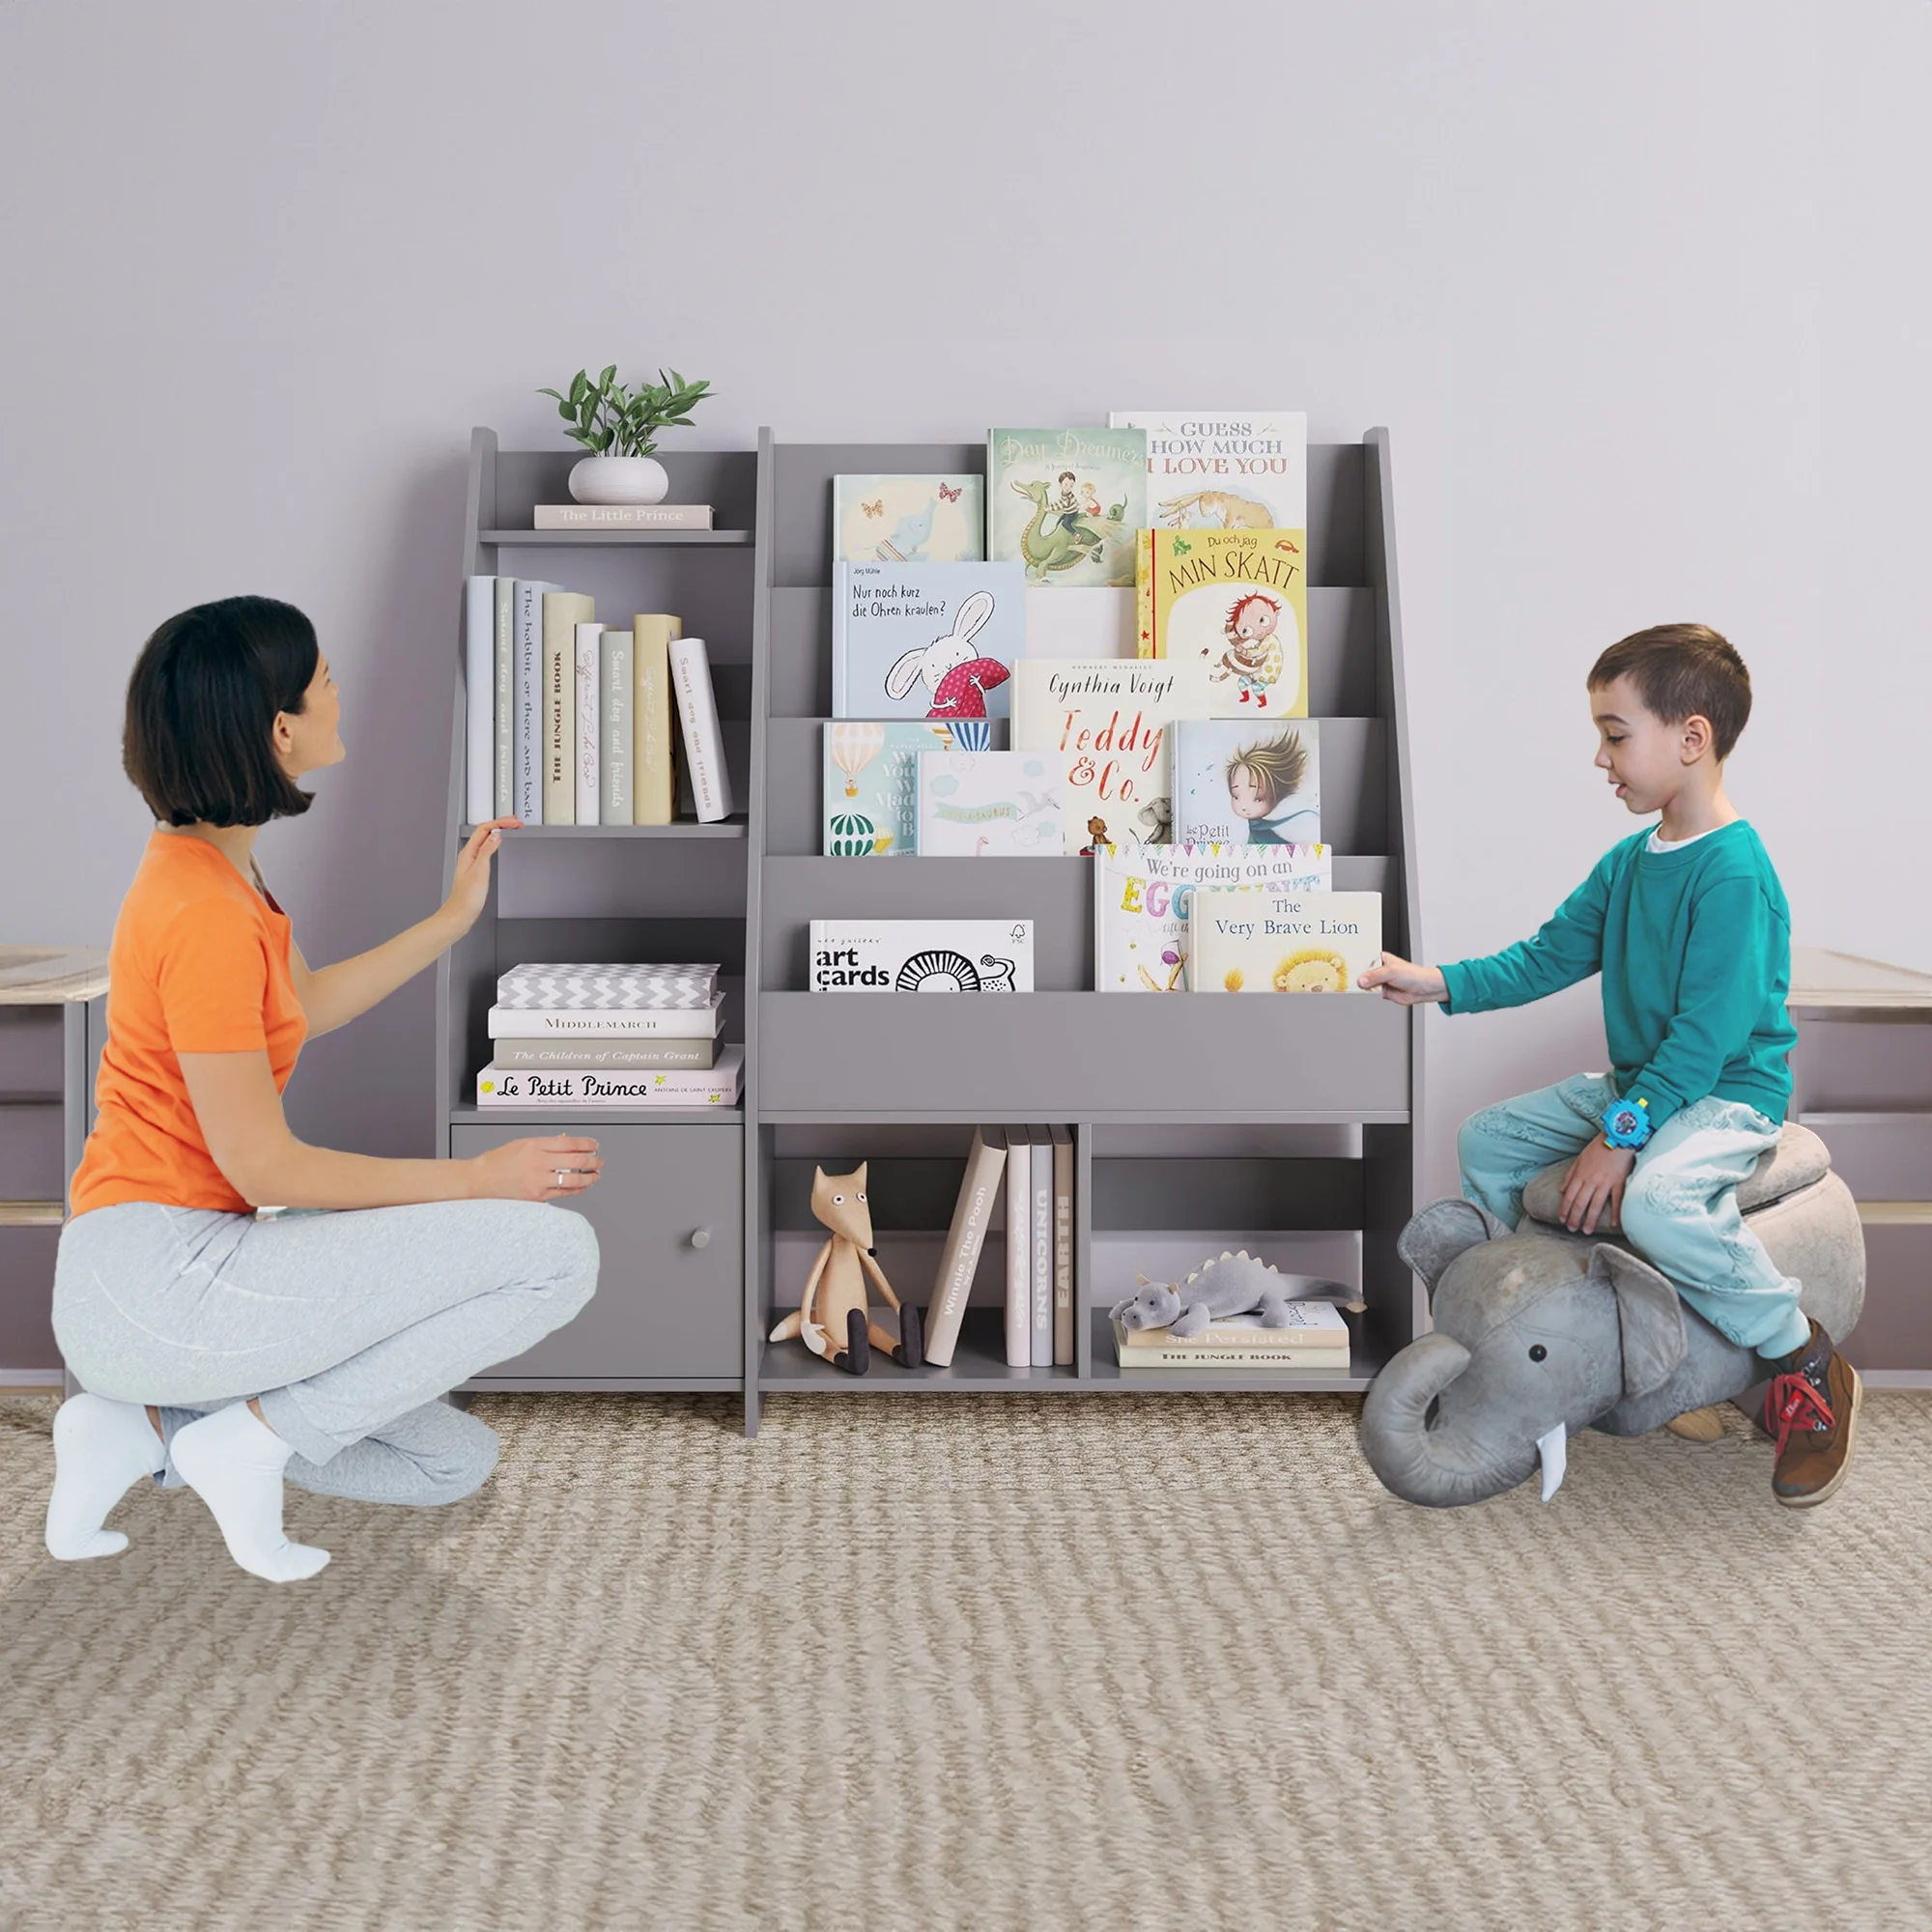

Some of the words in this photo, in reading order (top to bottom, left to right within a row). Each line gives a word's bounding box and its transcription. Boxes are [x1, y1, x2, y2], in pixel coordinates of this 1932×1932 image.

[1179, 421, 1253, 438] GUESS
[999, 435, 1045, 469] Day
[1056, 429, 1145, 468] Dreamers
[1151, 440, 1206, 455] HOW
[1212, 440, 1283, 455] MUCH
[1146, 457, 1154, 474] I
[1162, 457, 1230, 475] LOVE
[1235, 457, 1288, 475] YOU
[559, 508, 587, 522] The
[591, 508, 632, 522] Little
[636, 508, 685, 522] Prince
[1208, 536, 1221, 549] Du
[1222, 534, 1239, 545] och
[1238, 536, 1258, 551] jag
[1168, 554, 1216, 594] MIN
[1223, 550, 1300, 589] SKATT
[524, 585, 533, 617] The
[853, 583, 871, 599] Nur
[874, 583, 897, 599] noch
[900, 583, 921, 599] kurz
[852, 603, 867, 617] die
[870, 601, 901, 617] Ohren
[904, 600, 947, 616] kraulen?
[611, 650, 625, 693] Smart
[680, 657, 693, 695] Smart
[524, 680, 530, 698] or
[1049, 672, 1121, 703] Cynthia
[1129, 672, 1175, 703] Voigt
[524, 701, 533, 741] there
[610, 697, 625, 722] dog
[611, 729, 625, 753] and
[1060, 709, 1164, 772] Teddy
[553, 755, 561, 784] THE
[611, 761, 625, 808] friends
[524, 781, 533, 819] back
[875, 792, 914, 809] Mad
[1198, 823, 1230, 840] Petit
[1146, 857, 1189, 877] We're
[1194, 864, 1240, 884] going
[1245, 863, 1267, 877] on
[1271, 861, 1293, 874] an
[1120, 875, 1197, 921] EGG
[1271, 898, 1301, 914] The
[1214, 919, 1255, 941] Very
[1264, 919, 1312, 935] Brave
[1320, 919, 1359, 935] Lion
[816, 947, 859, 967] art
[816, 965, 891, 986] cards
[513, 1051, 535, 1061] The
[539, 1051, 591, 1061] Children
[595, 1051, 610, 1063] of
[611, 1051, 660, 1062] Captain
[664, 1051, 701, 1061] Grant
[497, 1075, 520, 1096] Le
[527, 1075, 574, 1096] Petit
[581, 1075, 647, 1096] Prince
[943, 1263, 966, 1317] Winnie
[958, 1231, 975, 1259] The
[968, 1186, 987, 1227] Pooh
[1036, 1188, 1048, 1331] UNICORNS
[1057, 1195, 1069, 1309] EARTH
[1205, 1332, 1305, 1345] Persisted
